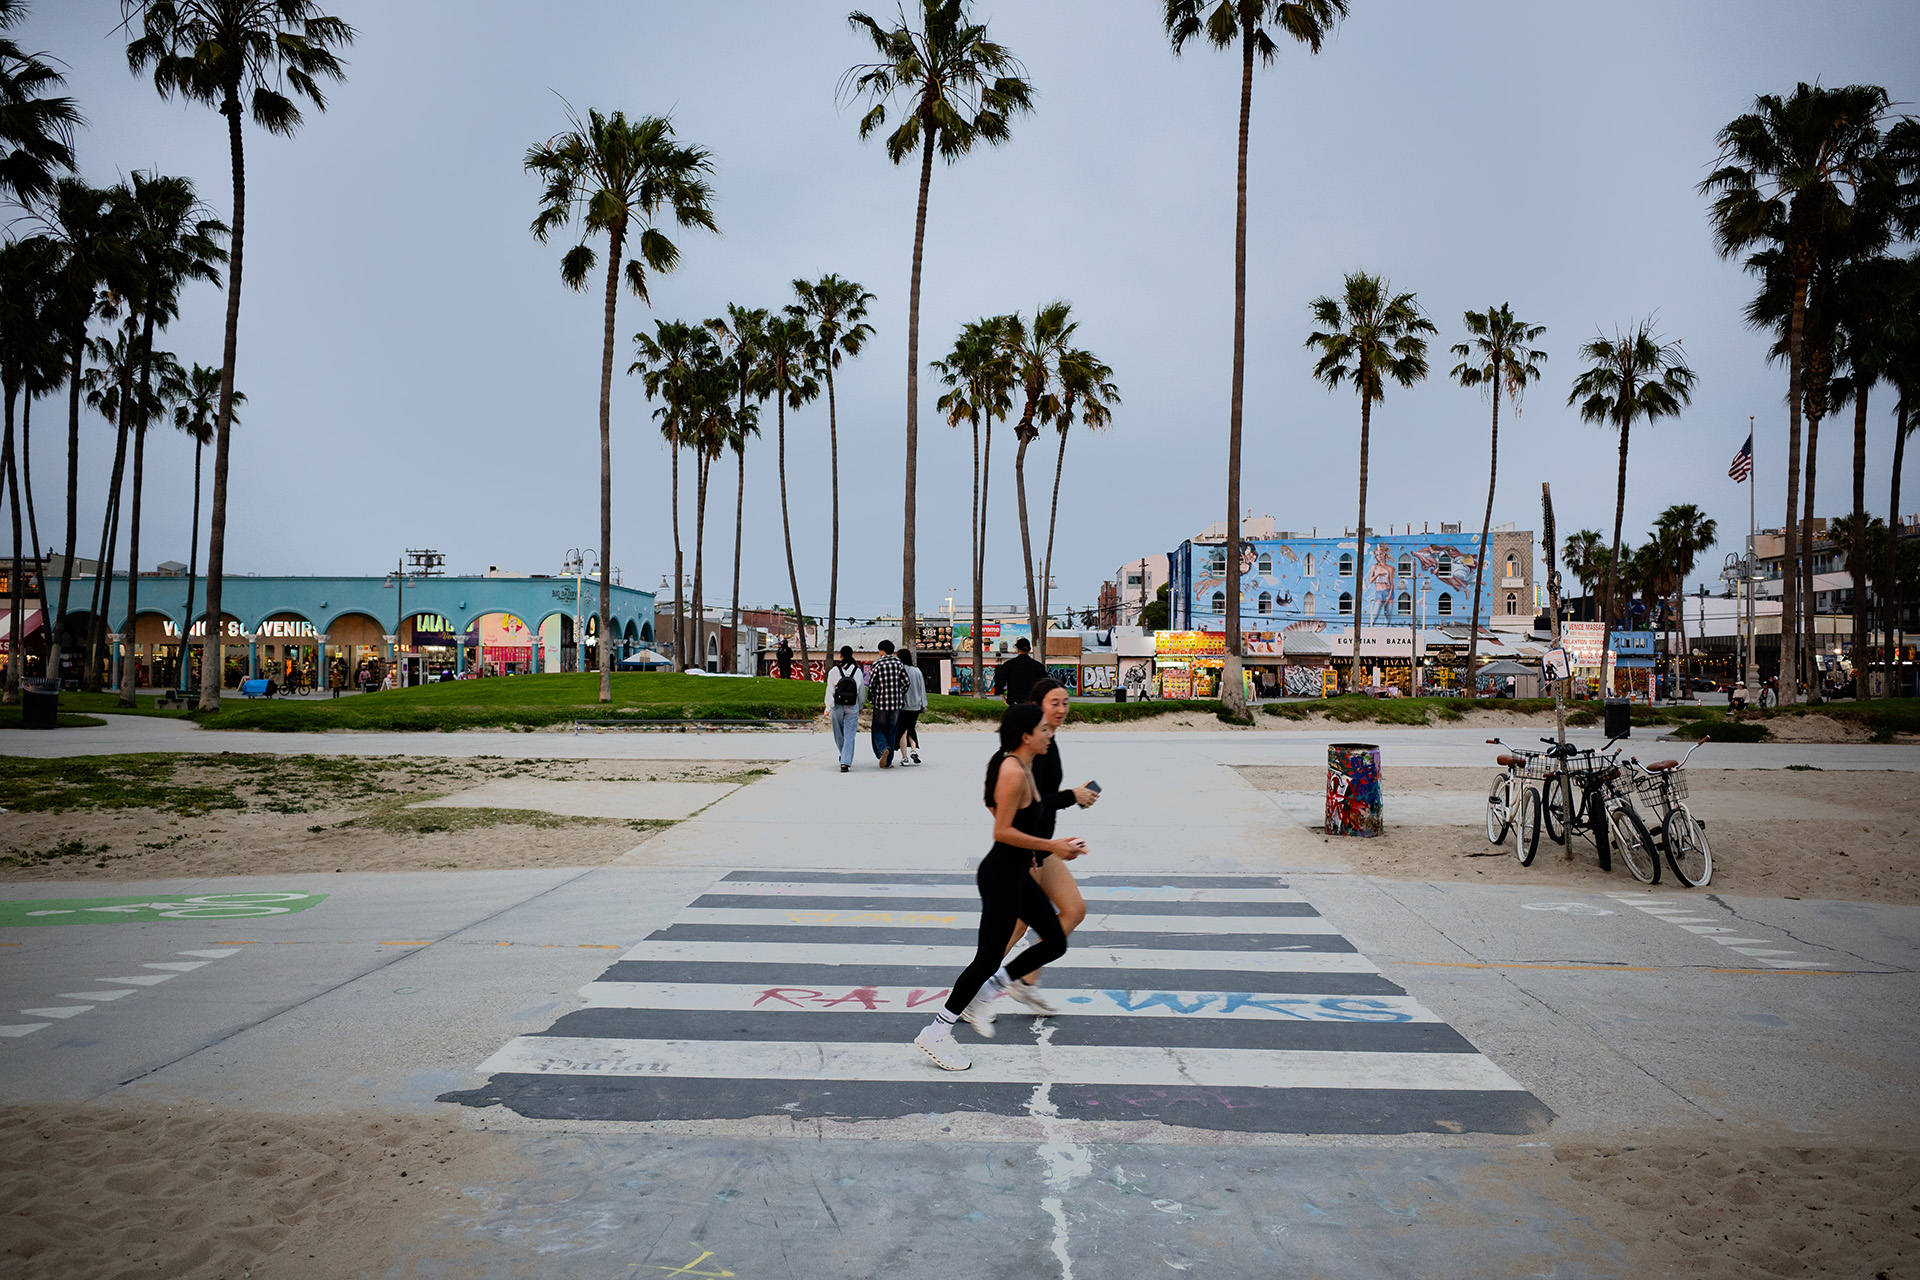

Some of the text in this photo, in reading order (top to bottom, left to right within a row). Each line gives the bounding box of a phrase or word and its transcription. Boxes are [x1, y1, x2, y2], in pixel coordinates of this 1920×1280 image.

[416, 614, 444, 632] LALA
[1568, 623, 1605, 631] VENICE MASSAG
[1577, 651, 1593, 659] VENICE
